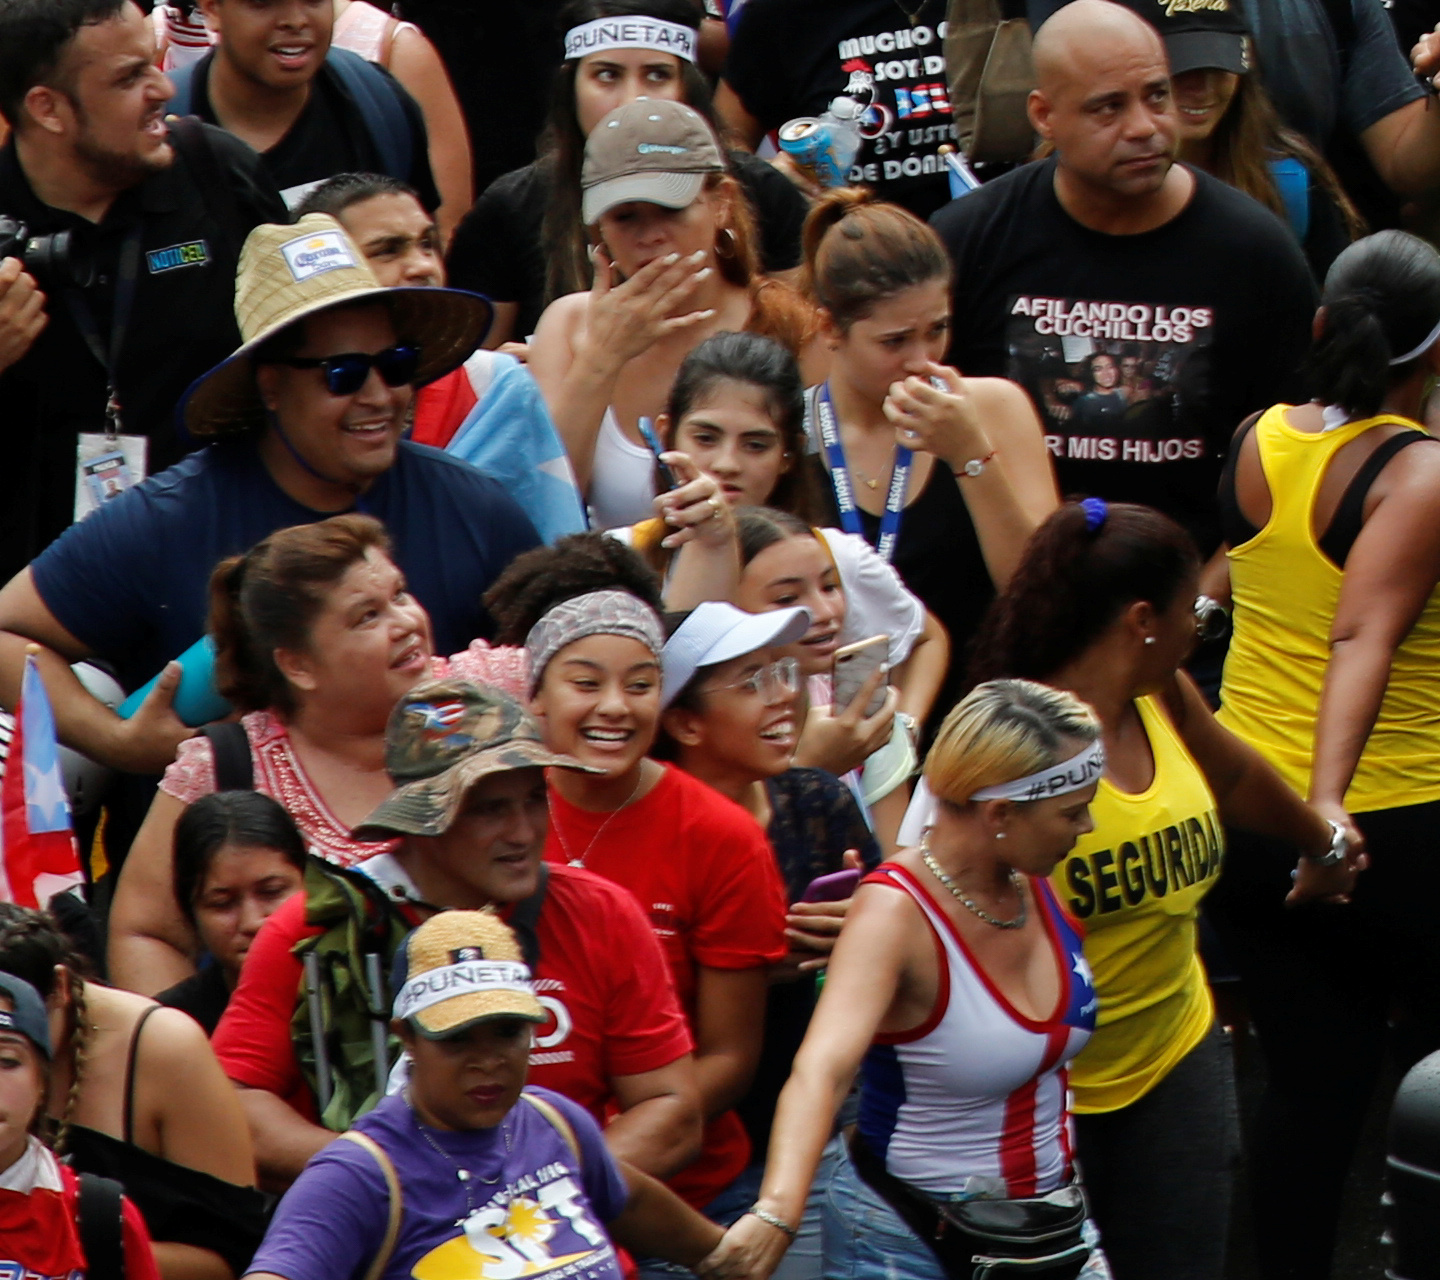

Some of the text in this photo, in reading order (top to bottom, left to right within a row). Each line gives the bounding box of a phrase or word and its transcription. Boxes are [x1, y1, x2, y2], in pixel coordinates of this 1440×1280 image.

[839, 26, 932, 61] MUCHO
[874, 60, 921, 81] SOY
[848, 161, 880, 182] DE
[1011, 297, 1214, 328] AFILANDO LOS
[1034, 318, 1194, 344] CUCHILLOS
[1067, 437, 1203, 463] MIS HIJOS
